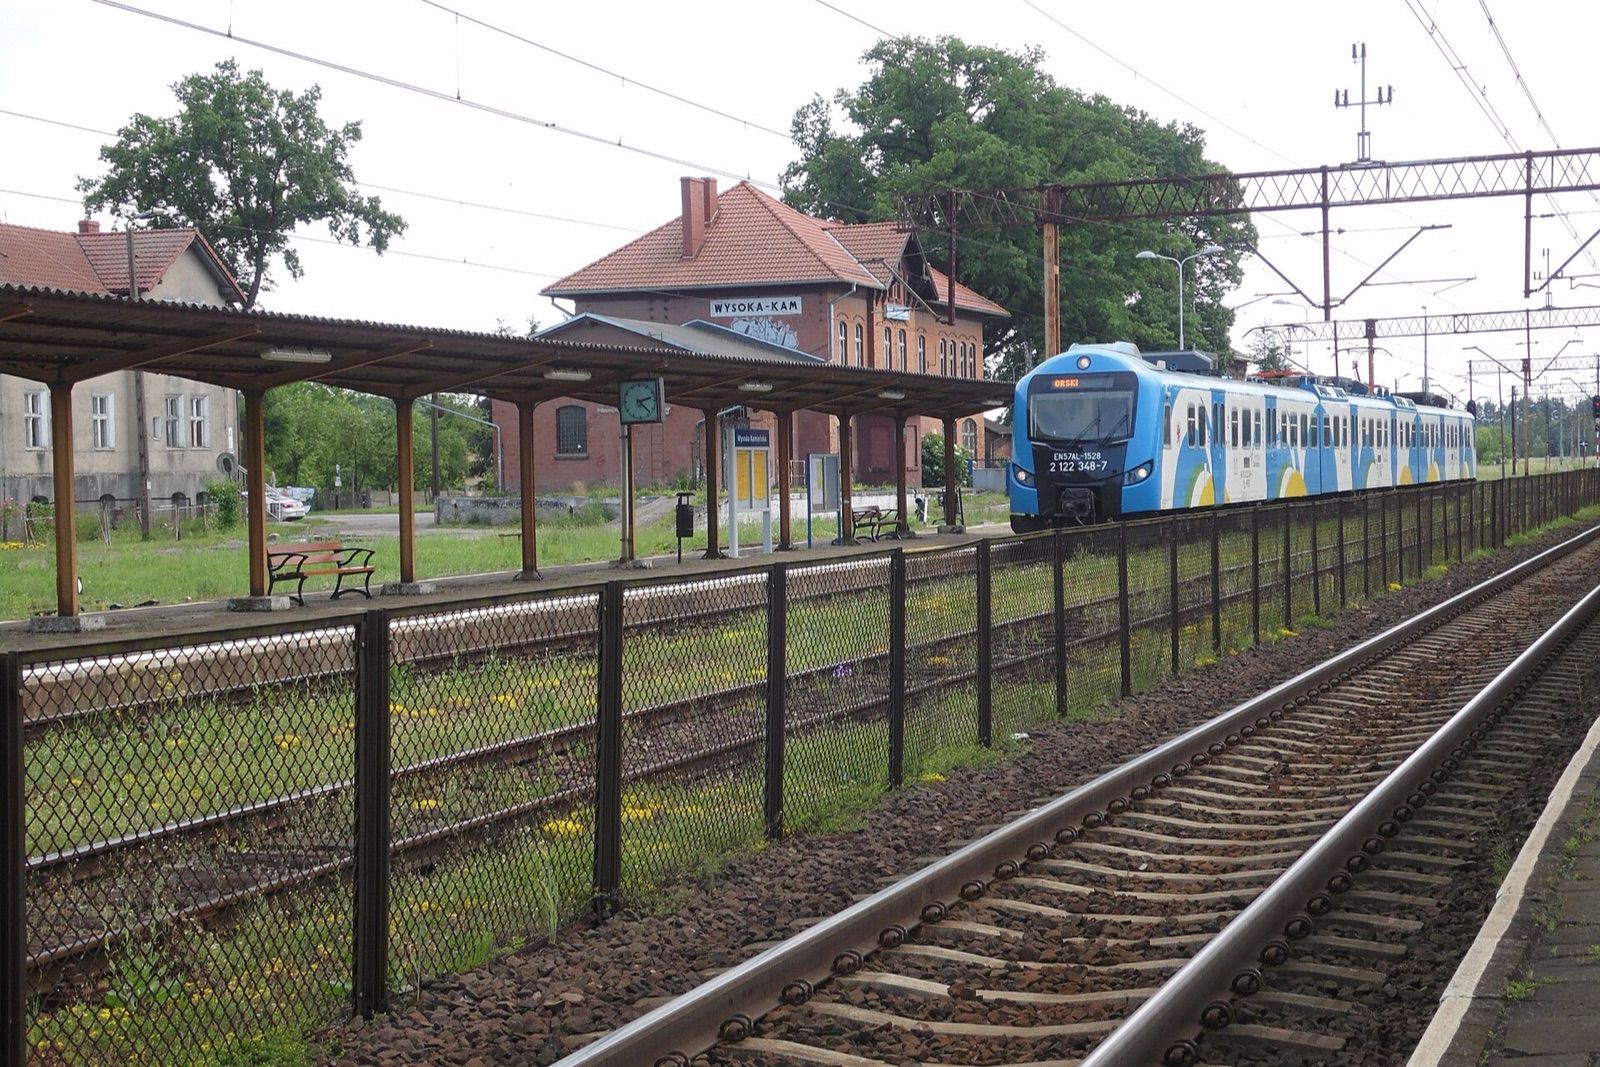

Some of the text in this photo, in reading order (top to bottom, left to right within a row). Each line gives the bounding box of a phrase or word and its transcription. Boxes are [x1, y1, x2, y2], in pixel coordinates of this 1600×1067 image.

[714, 301, 798, 313] WYSOKA-KAM
[1054, 379, 1079, 388] ORSKI
[1053, 452, 1102, 461] EN57AL-1528
[1050, 460, 1108, 472] 2 122 348-7
